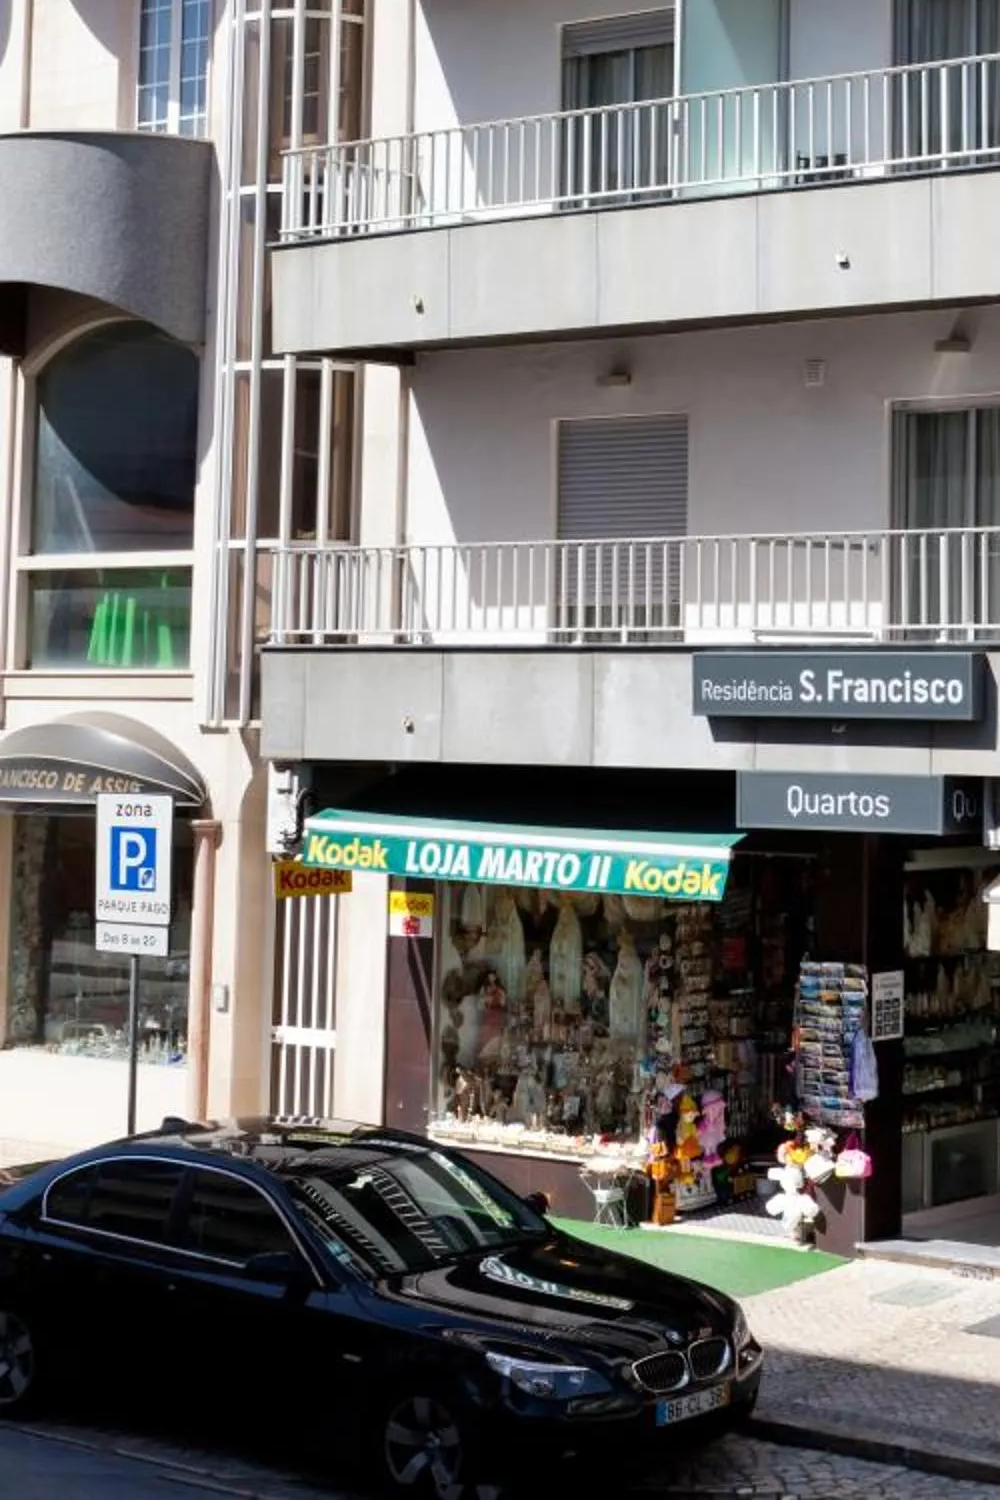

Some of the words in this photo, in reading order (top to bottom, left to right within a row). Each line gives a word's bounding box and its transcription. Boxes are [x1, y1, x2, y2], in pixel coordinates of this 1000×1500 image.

[702, 678, 793, 702] Residência
[63, 772, 87, 793] DE
[116, 803, 152, 817] zona
[786, 785, 890, 818] Quartos
[119, 831, 147, 885] P
[307, 835, 388, 869] Kodak
[405, 841, 471, 877] LOJA
[477, 846, 581, 886] MARTO
[623, 860, 721, 896] Kodak
[280, 868, 346, 890] Kodak
[99, 899, 137, 913] PARQUE
